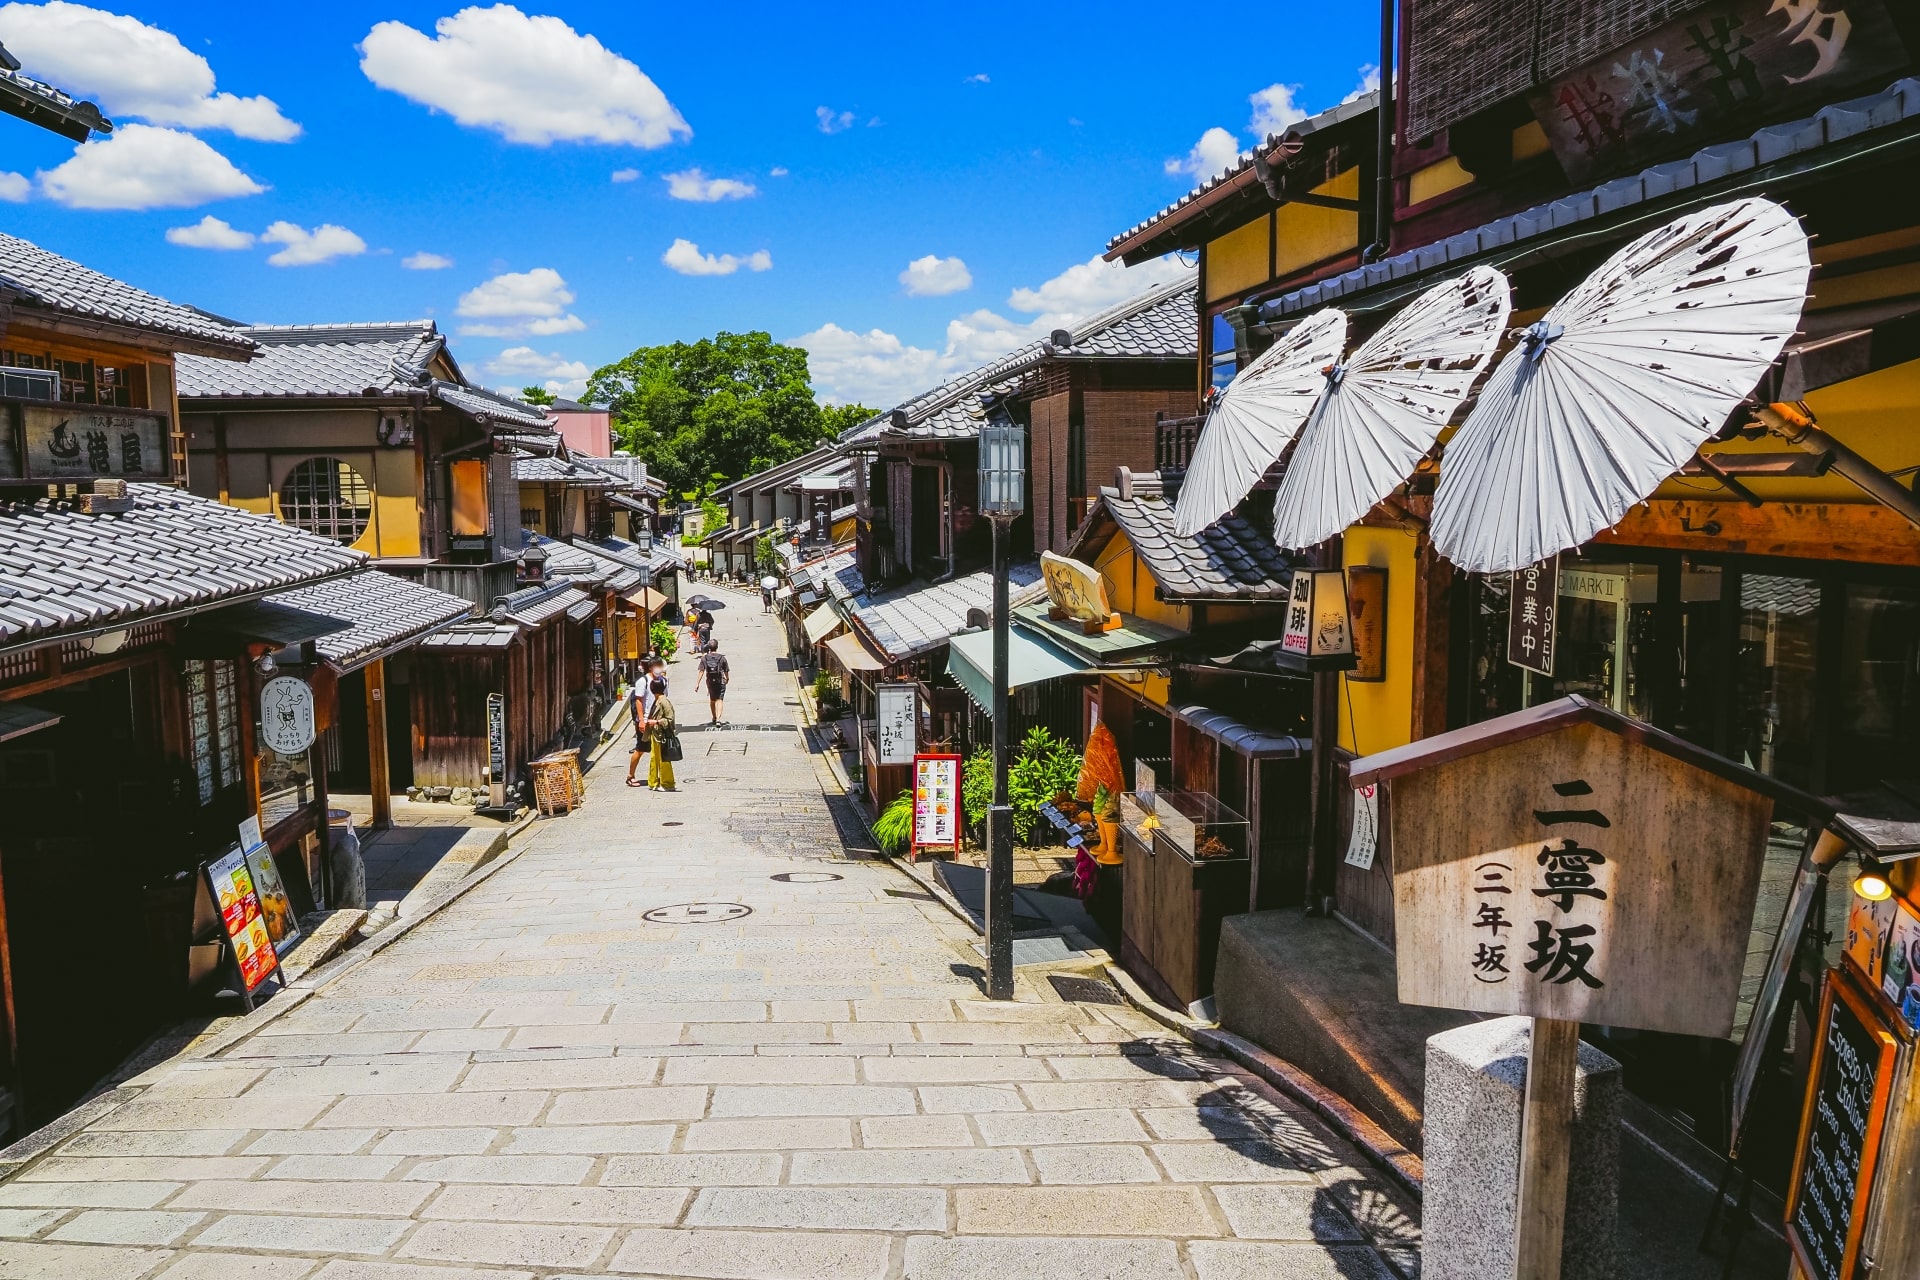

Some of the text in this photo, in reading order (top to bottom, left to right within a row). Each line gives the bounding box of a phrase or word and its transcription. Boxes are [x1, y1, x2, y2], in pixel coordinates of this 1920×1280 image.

[1290, 577, 1310, 632] 珈琲
[1521, 563, 1540, 658] 営業中
[1569, 575, 1603, 595] MARK
[1284, 633, 1308, 650] COFFEE
[1541, 605, 1553, 672] OPEN
[904, 693, 914, 722] そば処
[881, 726, 895, 757] ふたば
[1522, 779, 1612, 990] 二寧坂
[1828, 1002, 1861, 1082] Espresso
